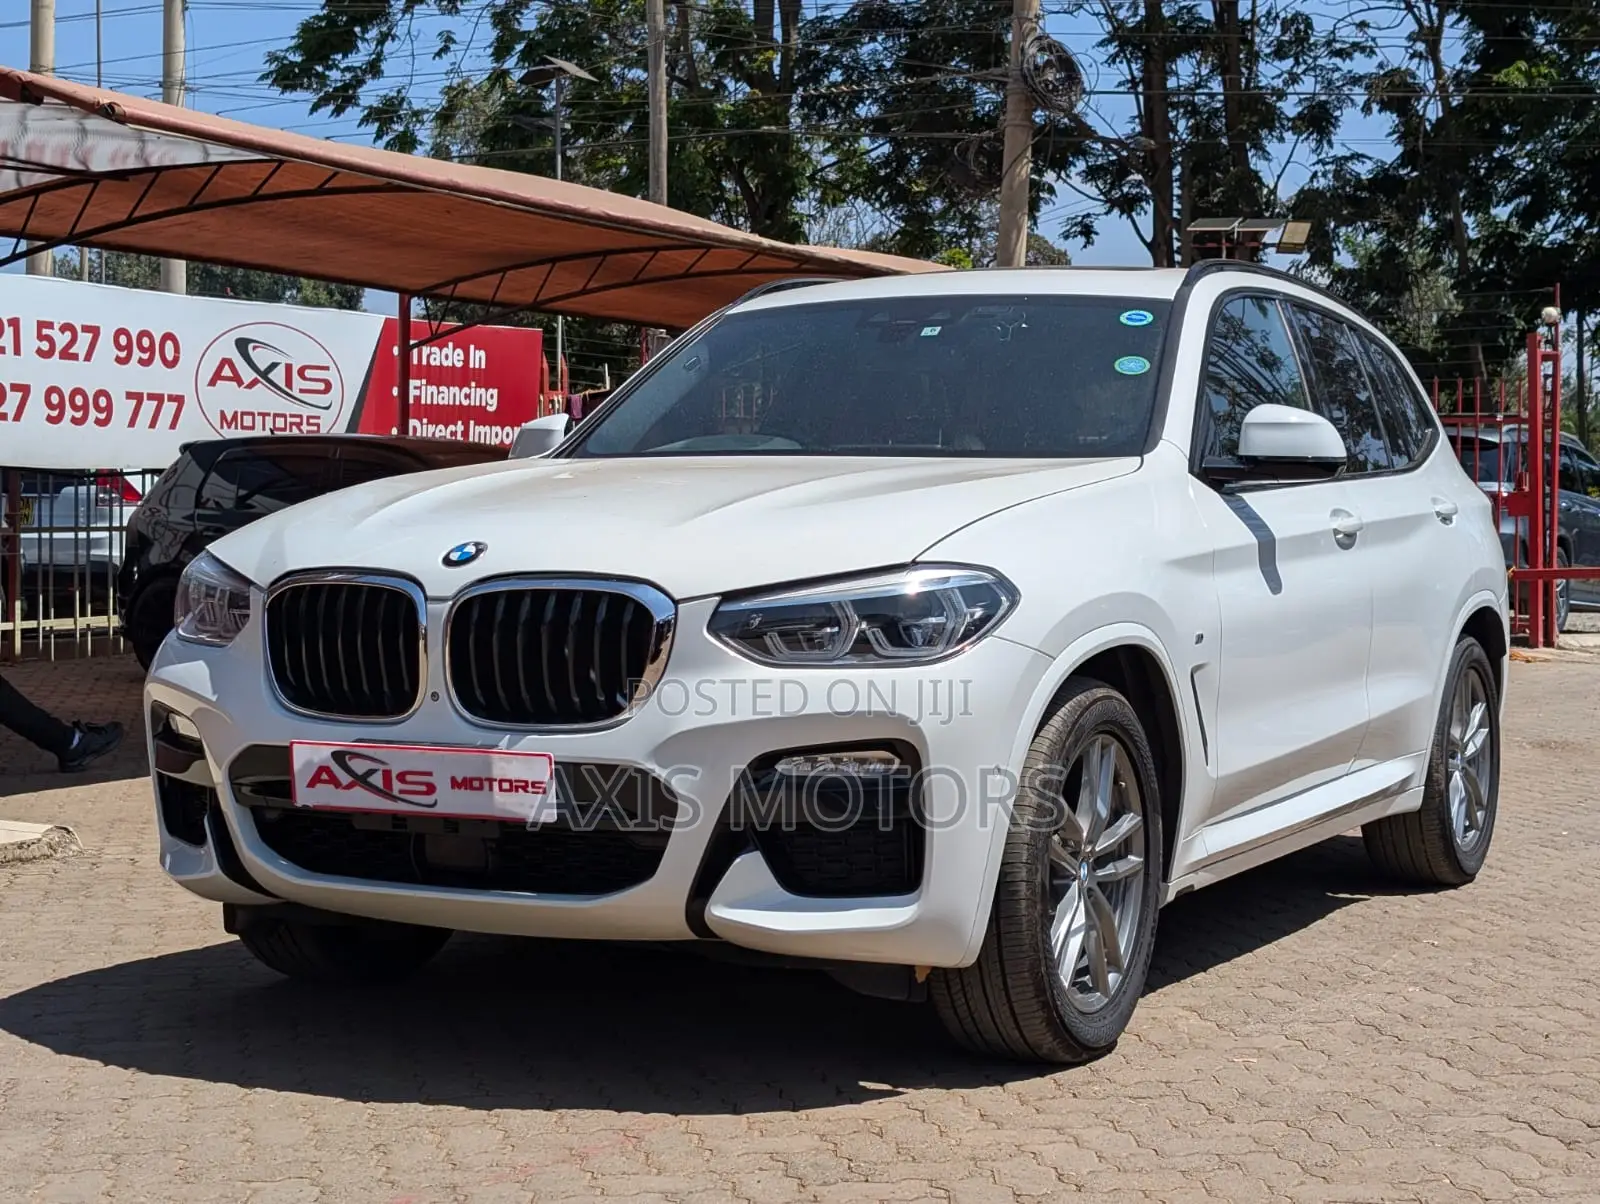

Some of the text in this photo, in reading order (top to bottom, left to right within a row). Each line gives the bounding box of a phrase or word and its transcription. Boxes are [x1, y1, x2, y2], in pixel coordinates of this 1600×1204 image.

[34, 319, 101, 362] 527
[112, 327, 181, 369] 990
[409, 339, 486, 369] Trade In
[206, 343, 333, 406] AXIS
[43, 385, 114, 427] 999
[125, 390, 186, 430] 777
[408, 379, 498, 412] Financing
[219, 409, 321, 434] MOTORS
[408, 418, 464, 441] Direct
[305, 754, 548, 805] AXIS MOTORS
